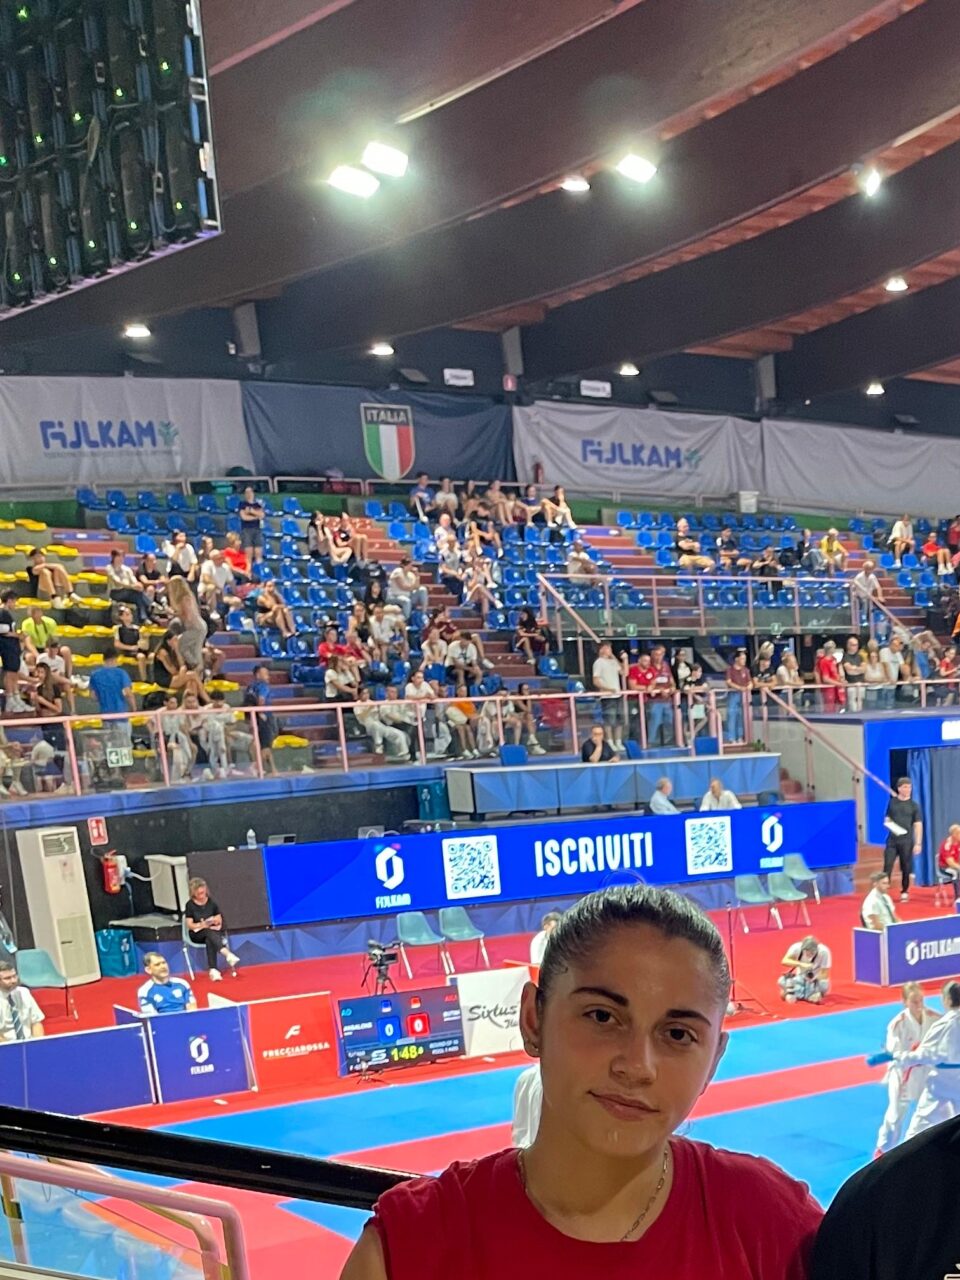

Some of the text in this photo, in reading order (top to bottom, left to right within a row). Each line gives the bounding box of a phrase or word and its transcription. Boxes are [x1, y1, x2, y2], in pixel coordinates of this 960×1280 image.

[365, 407, 408, 423] ITALIA
[534, 831, 655, 877] ISCRIVITI
[467, 1003, 518, 1028] Sixtus
[262, 1042, 331, 1058] FRECCIAROSSA
